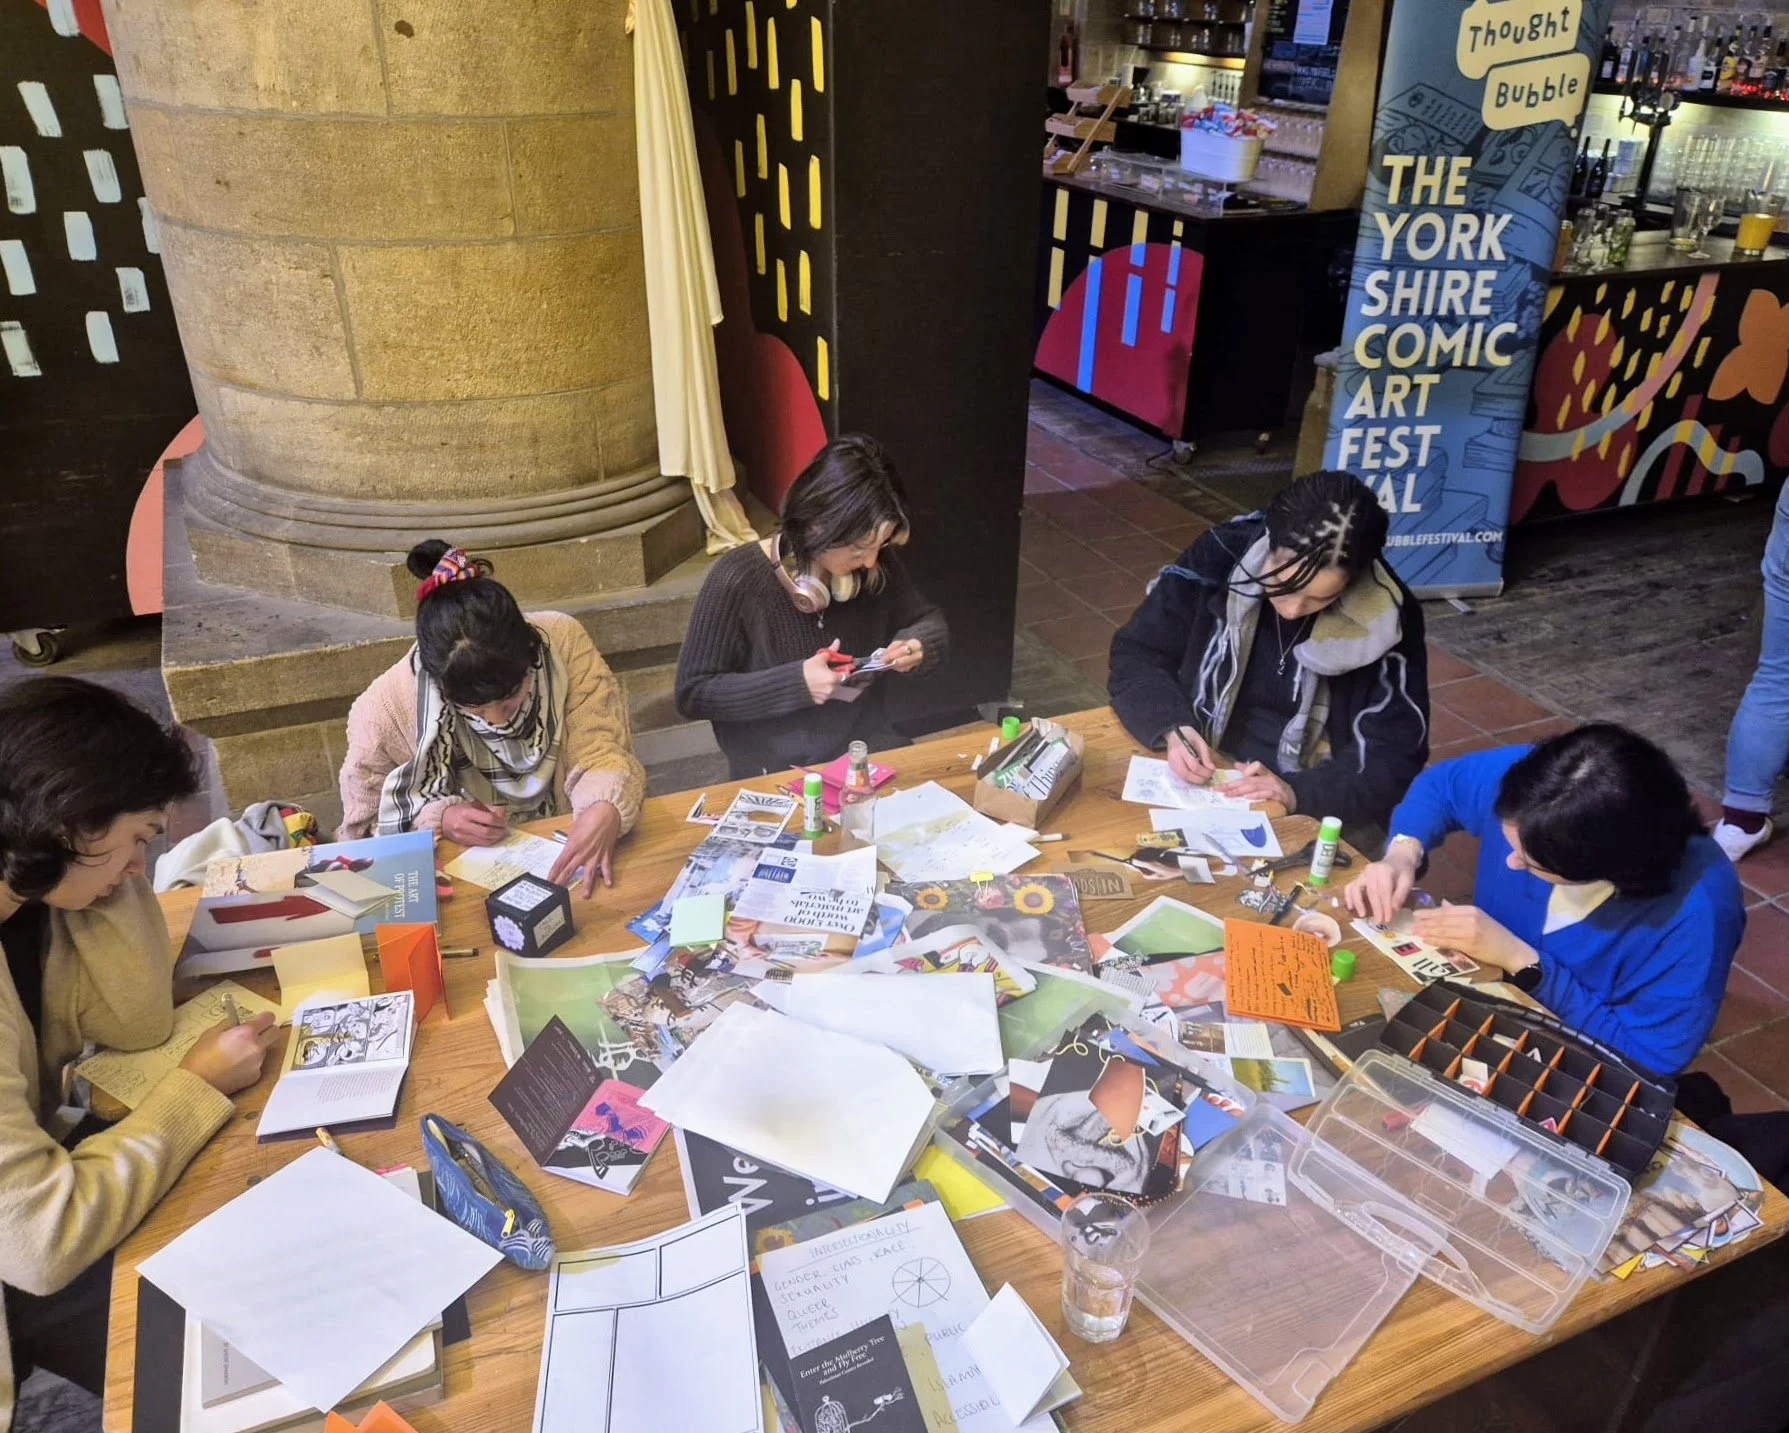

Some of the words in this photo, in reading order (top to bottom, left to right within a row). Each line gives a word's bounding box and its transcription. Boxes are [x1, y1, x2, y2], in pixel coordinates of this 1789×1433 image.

[1469, 6, 1570, 53] Thought
[1495, 73, 1578, 109] Bubble
[1382, 154, 1472, 206] THE
[1374, 212, 1513, 261] YORK
[1360, 269, 1497, 317] SHIRE
[1354, 321, 1518, 369] COMIC
[1343, 373, 1441, 420] ART
[1337, 424, 1442, 471] FEST
[1364, 472, 1422, 514] AL
[1386, 530, 1504, 548] UBBLEFESTIVAL.COM
[394, 873, 405, 882] OF
[407, 870, 419, 887] THE
[407, 888, 419, 904] ART
[790, 899, 844, 912] materials
[813, 909, 848, 921] worth
[828, 919, 855, 933] Over
[800, 1365, 821, 1379] Enter
[821, 1358, 834, 1370] the
[835, 1343, 868, 1364] Mulberry
[869, 1335, 886, 1347] Tree
[822, 1366, 837, 1377] and
[851, 1351, 867, 1363] Free
